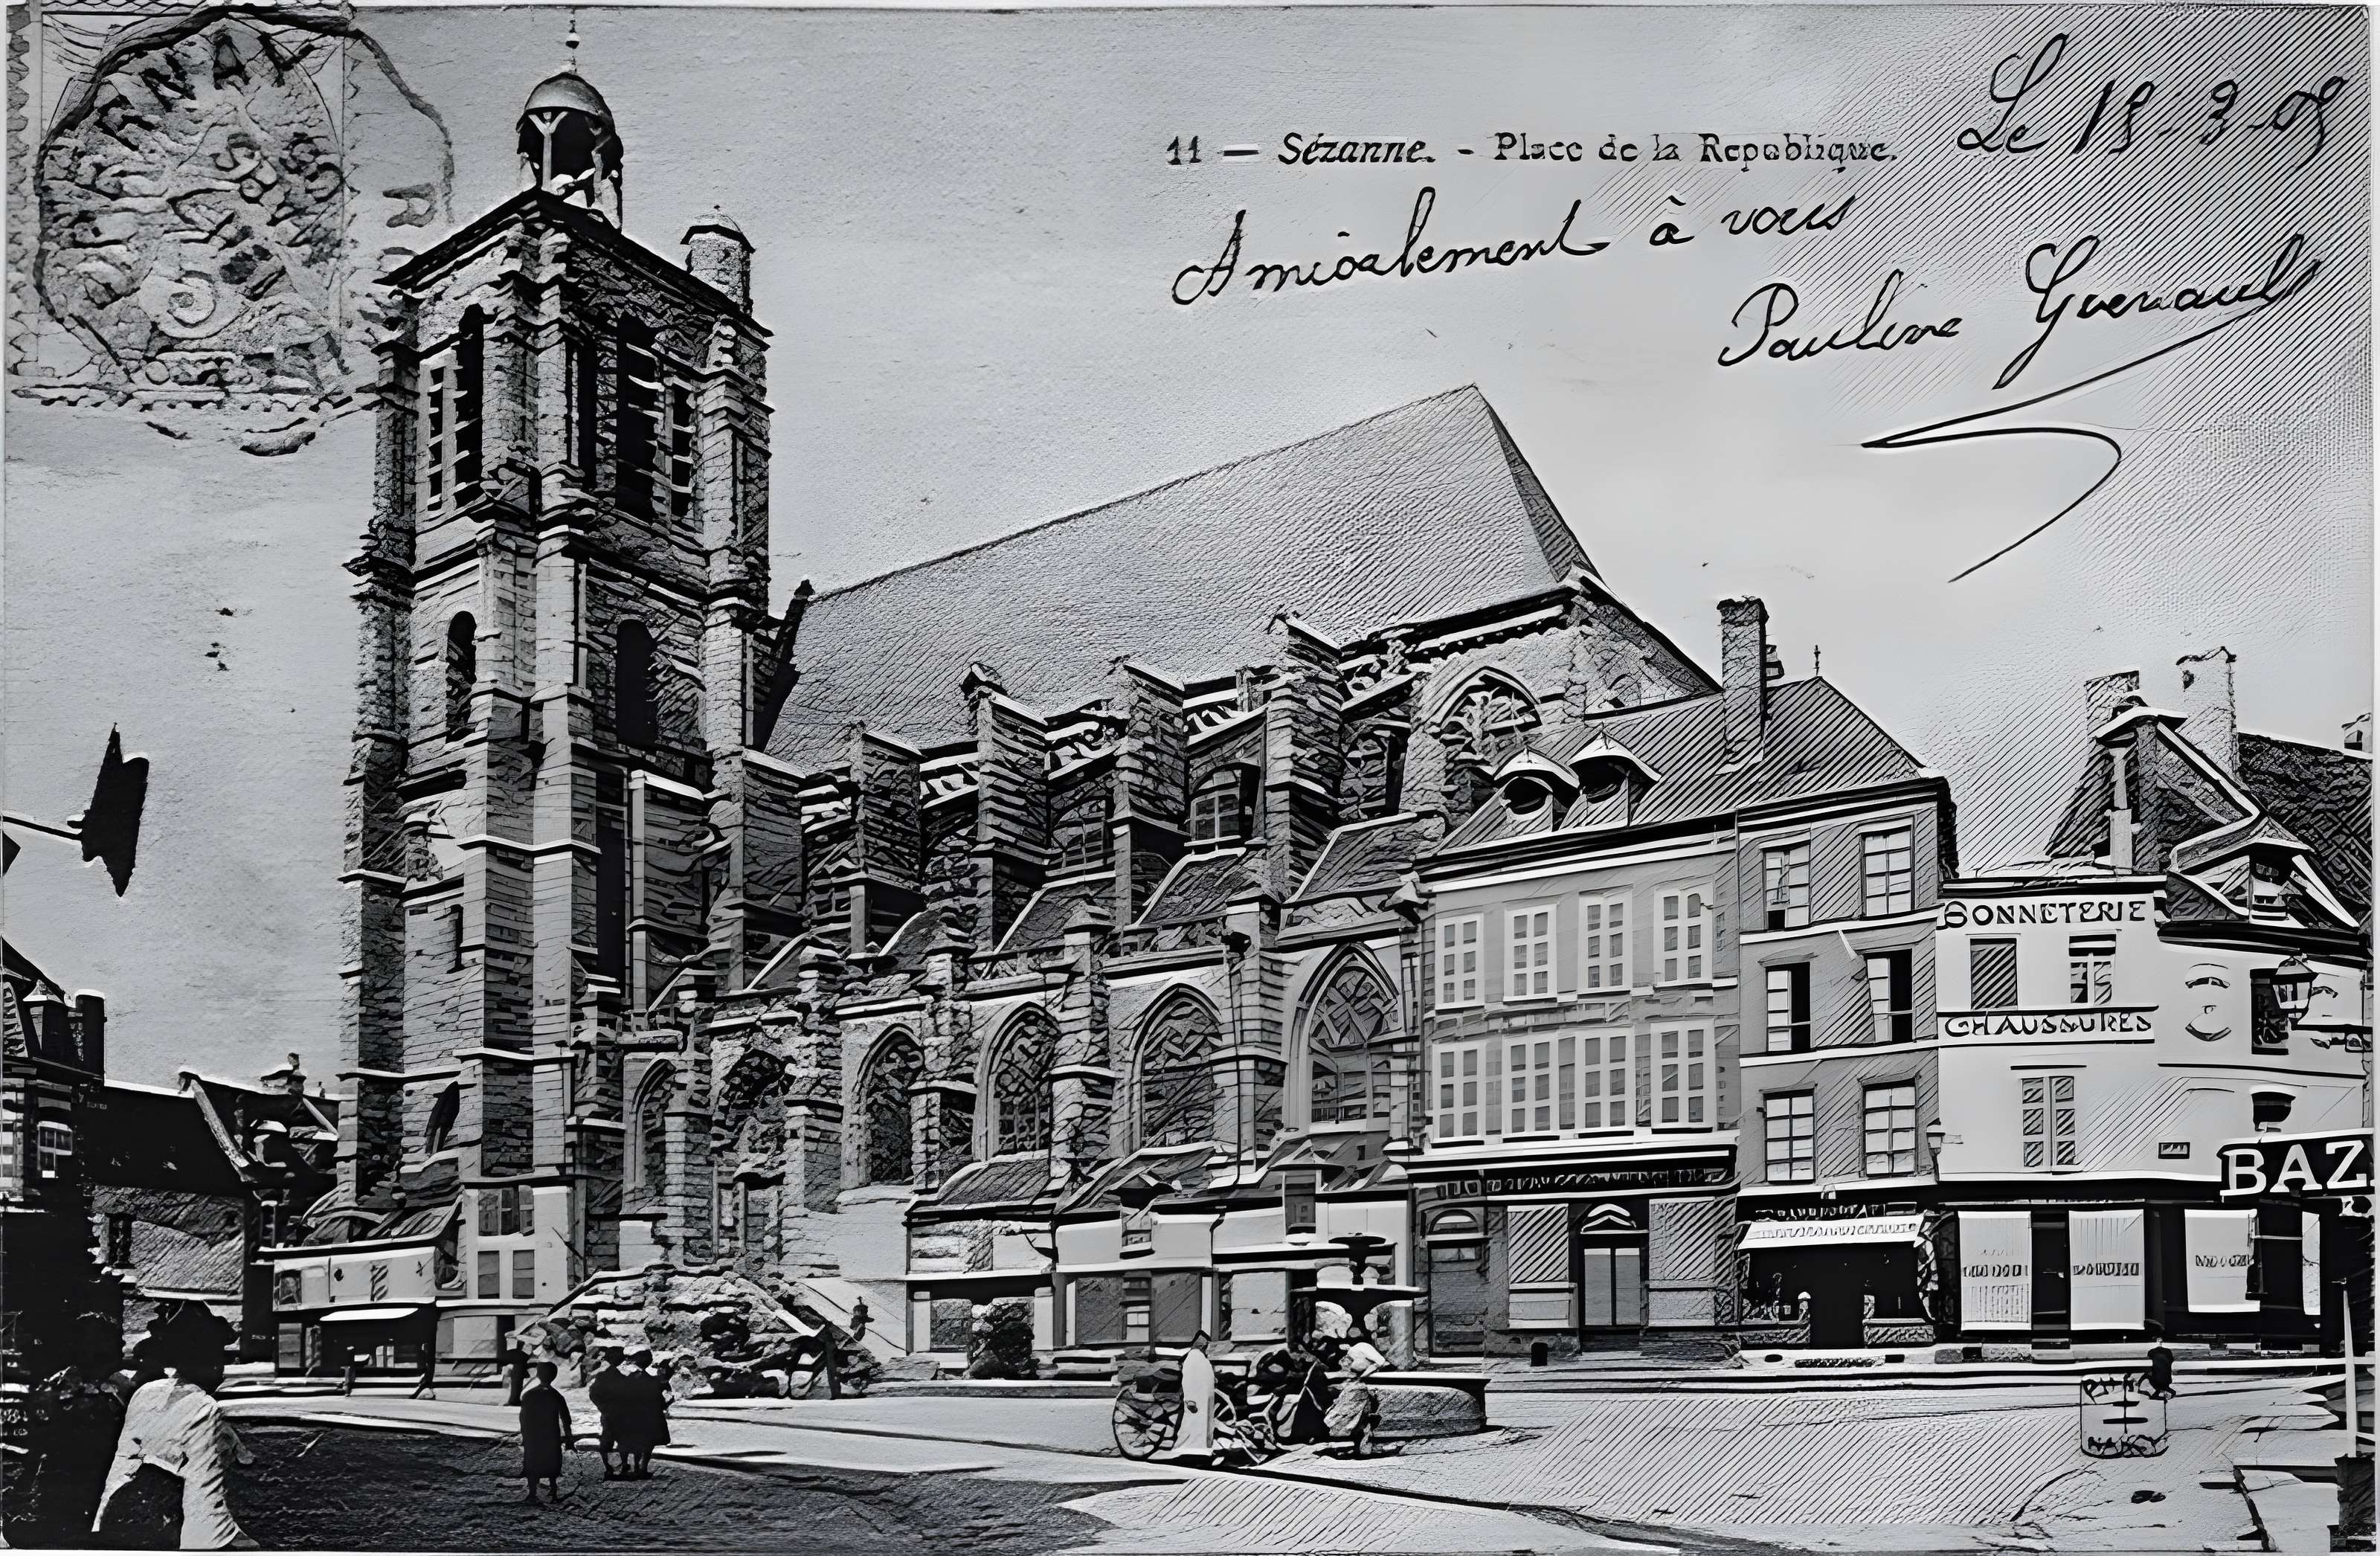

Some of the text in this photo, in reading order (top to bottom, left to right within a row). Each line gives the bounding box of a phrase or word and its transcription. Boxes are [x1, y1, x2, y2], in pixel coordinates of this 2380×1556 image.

[1649, 195, 1695, 246] à
[1720, 194, 1857, 236] vous
[1717, 269, 1963, 367] Pauline
[1943, 900, 2146, 928] BONNETERIE
[1944, 1011, 2152, 1038] CHAUSSURES
[2219, 1139, 2375, 1197] BAZ
